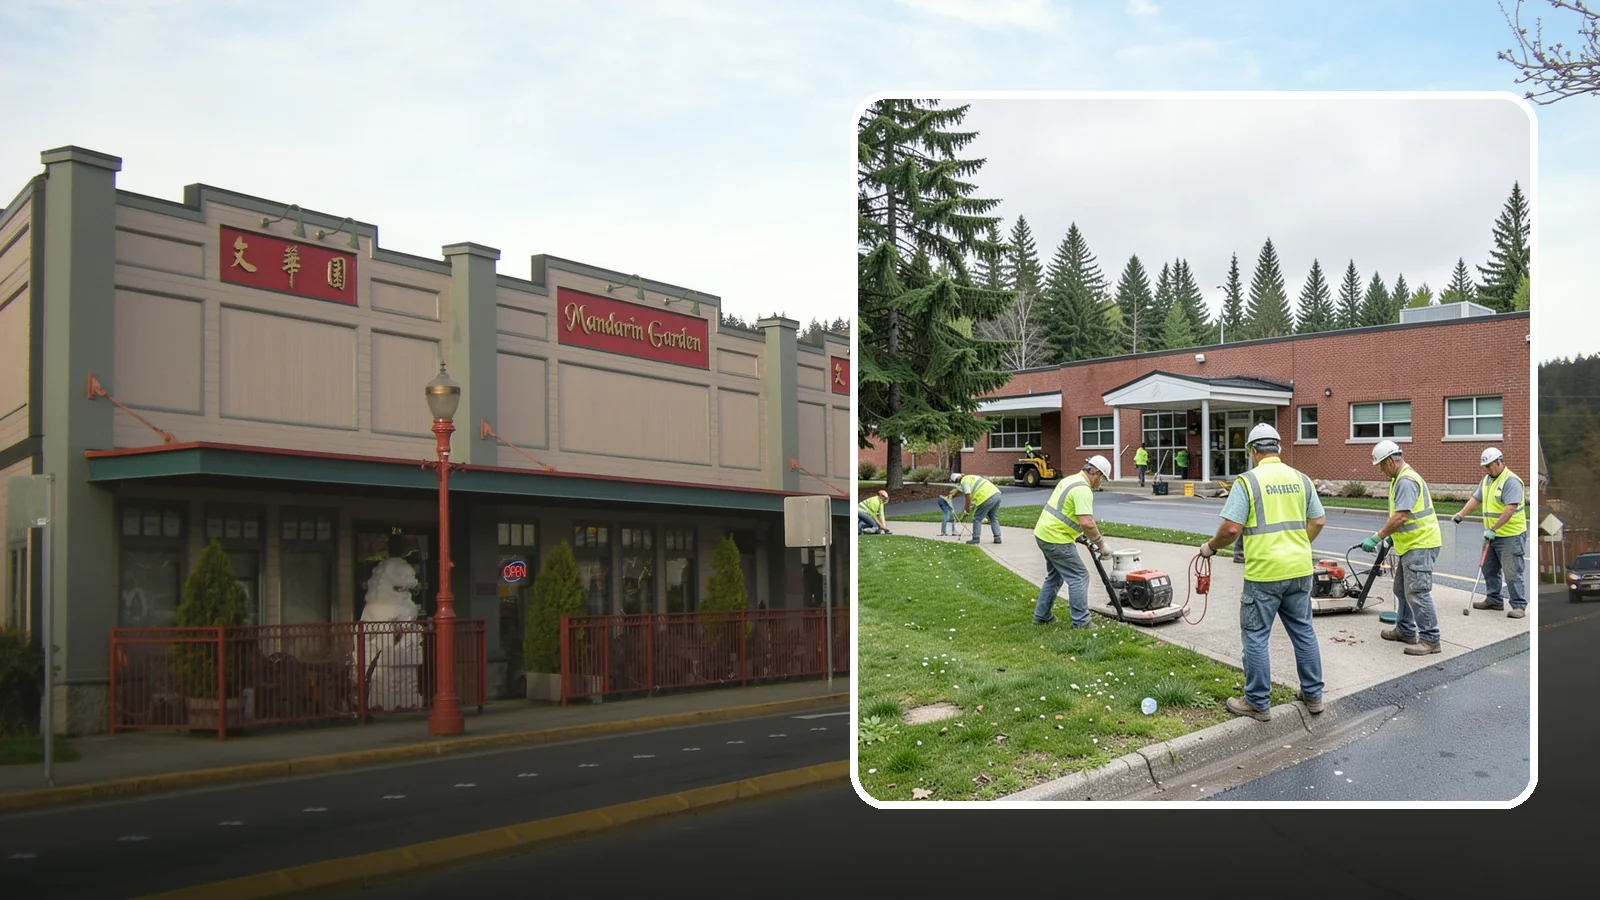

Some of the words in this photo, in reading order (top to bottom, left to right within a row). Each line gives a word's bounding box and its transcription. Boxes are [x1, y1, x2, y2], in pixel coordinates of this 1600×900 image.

[231, 236, 346, 290] 文華園
[564, 302, 644, 341] Mandarin
[647, 320, 702, 352] Garden
[503, 565, 527, 578] OPEN
